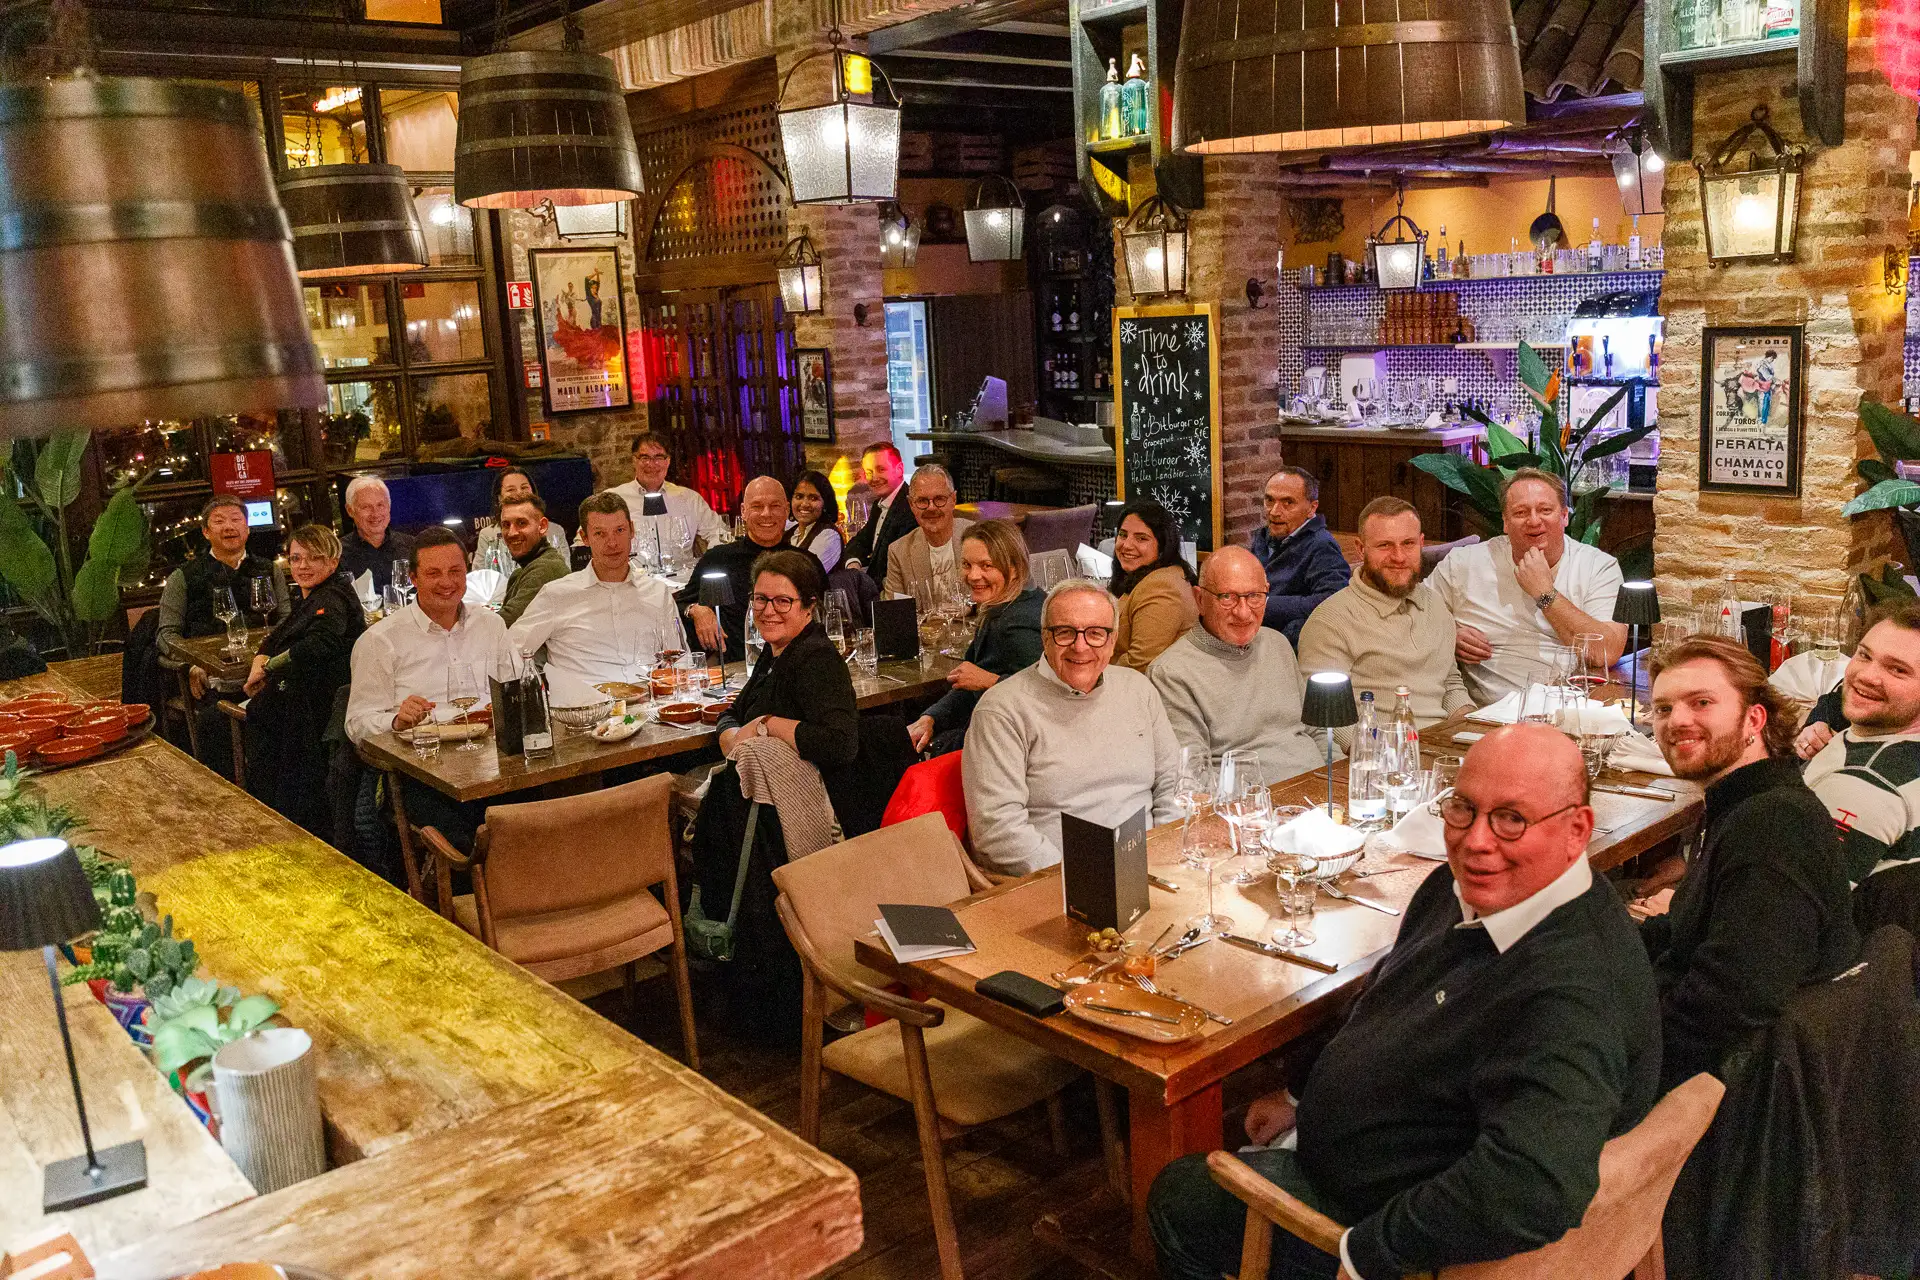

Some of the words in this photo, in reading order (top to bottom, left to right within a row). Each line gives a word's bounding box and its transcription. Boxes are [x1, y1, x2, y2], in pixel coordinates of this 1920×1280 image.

[1138, 328, 1181, 352] Time
[1153, 353, 1167, 369] to
[1139, 354, 1189, 399] drink
[557, 386, 580, 395] MARIA
[1145, 412, 1192, 437] Bitburger
[1715, 439, 1784, 451] PERALTA
[1130, 450, 1181, 470] Bitburger
[1715, 457, 1784, 470] CHAMACO
[1732, 470, 1783, 479] OSUNA
